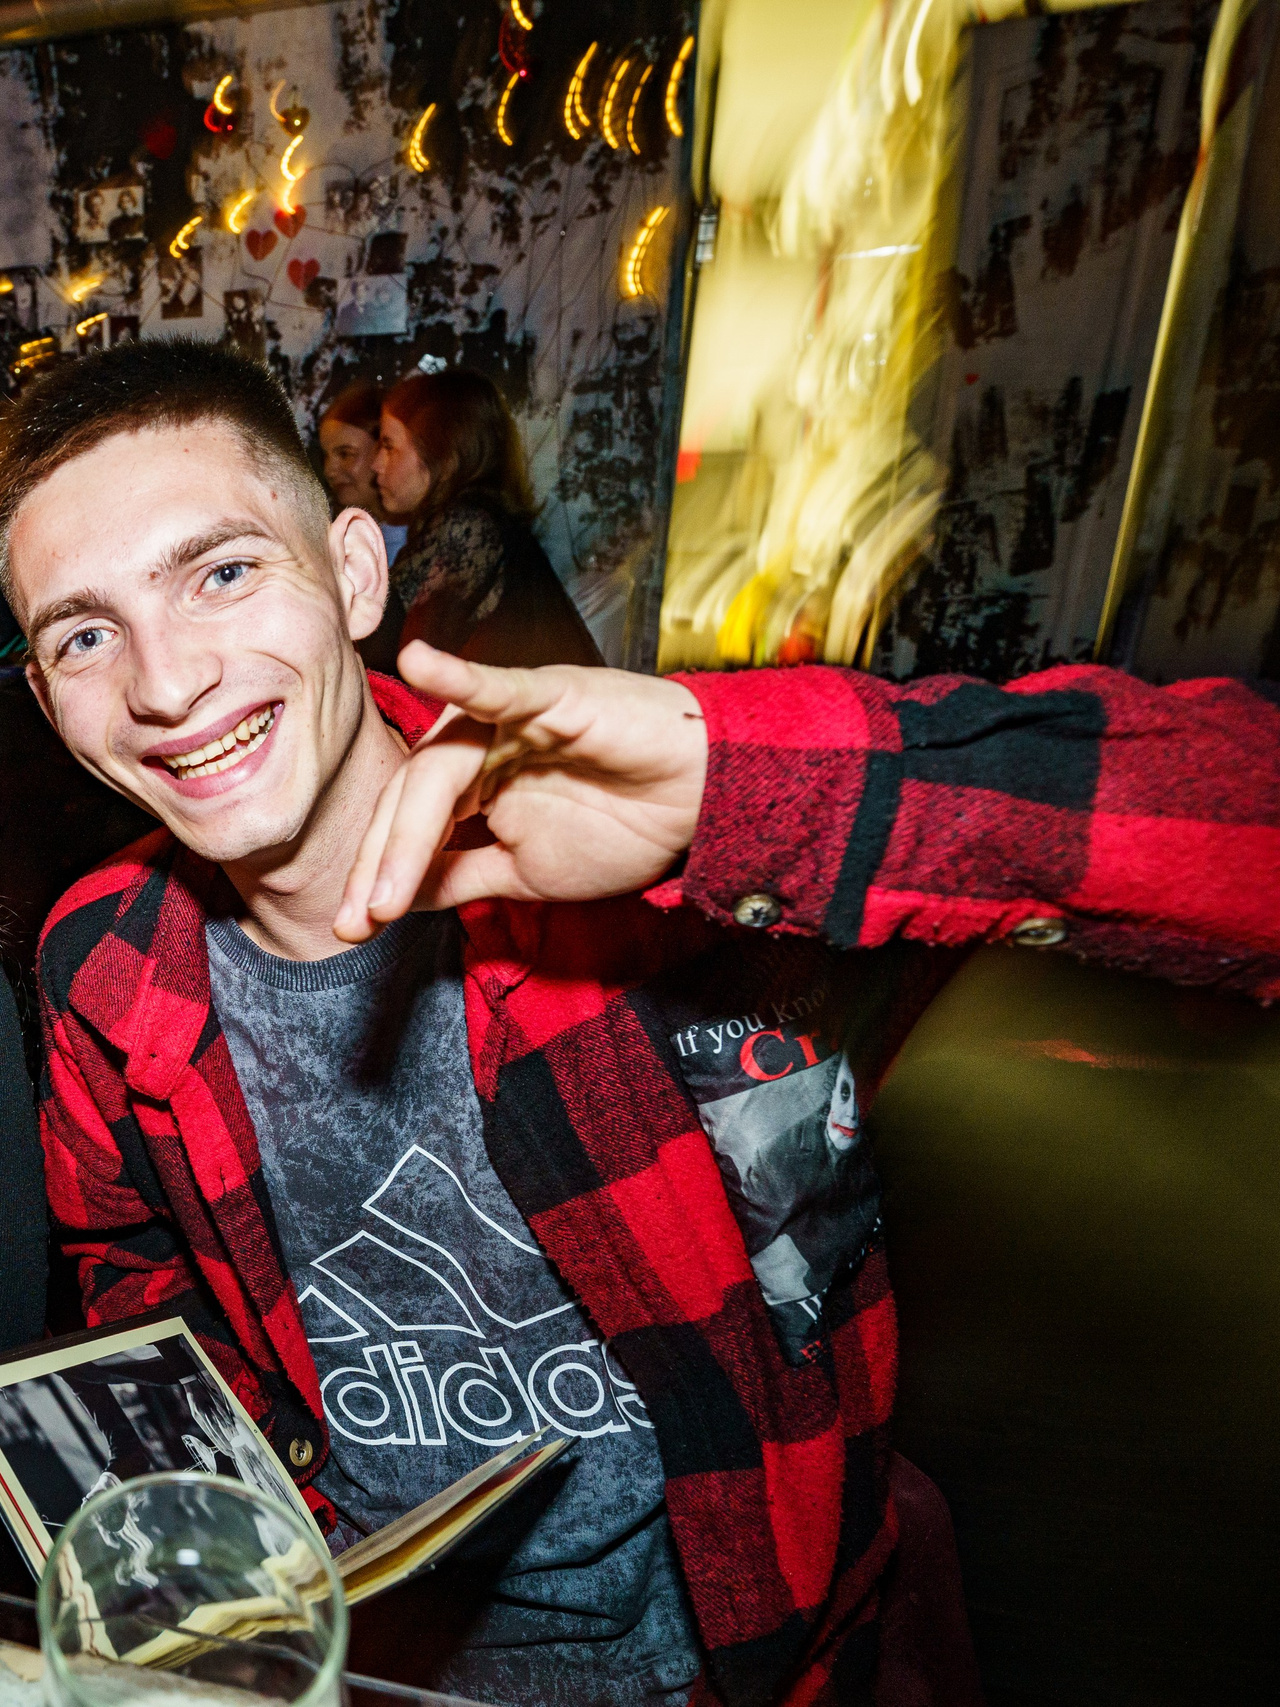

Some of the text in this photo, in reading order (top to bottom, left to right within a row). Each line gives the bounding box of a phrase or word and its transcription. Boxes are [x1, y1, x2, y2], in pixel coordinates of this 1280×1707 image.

[676, 989, 827, 1057] If you kno
[739, 1027, 836, 1081] Cr
